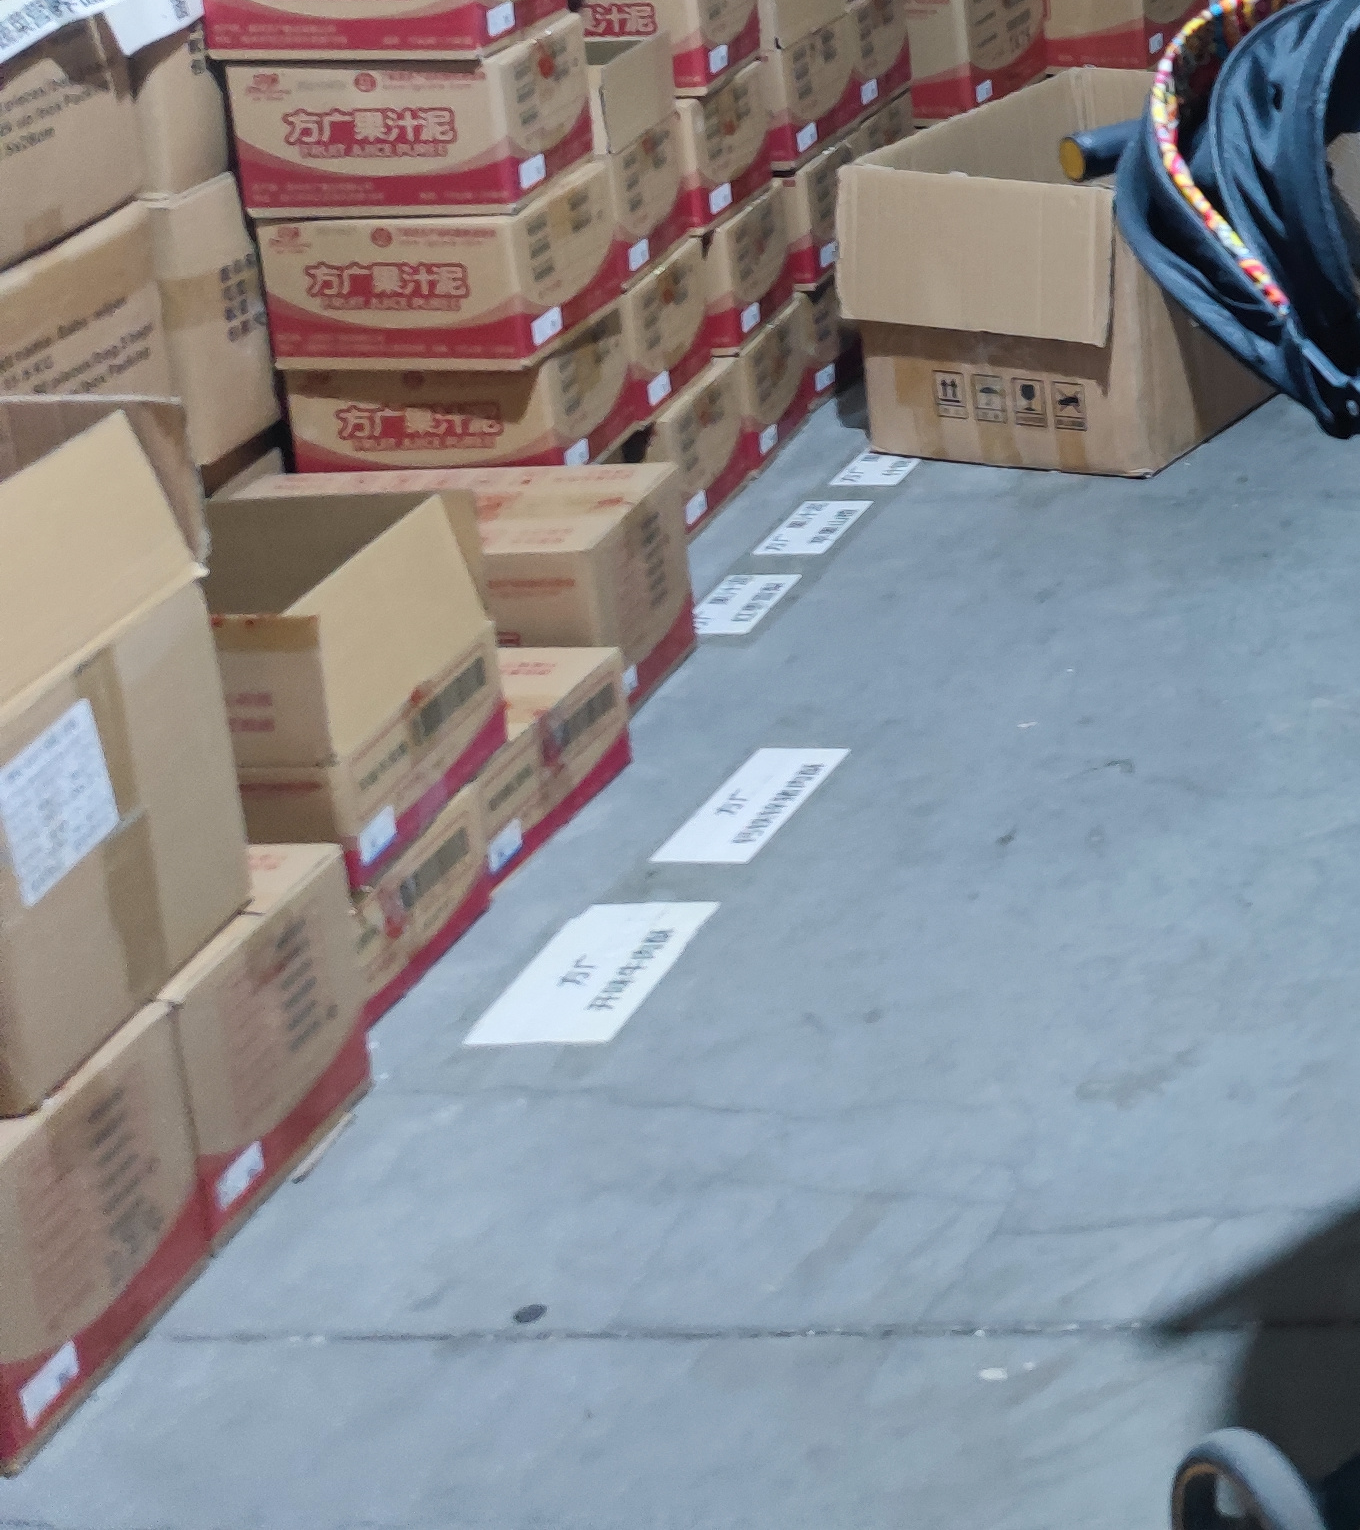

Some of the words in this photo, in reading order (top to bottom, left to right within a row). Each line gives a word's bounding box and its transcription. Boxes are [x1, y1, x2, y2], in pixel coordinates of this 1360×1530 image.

[284, 107, 458, 145] 方广果汁泥
[306, 261, 470, 299] 方广果汁泥
[714, 789, 743, 818] 方广
[556, 954, 596, 990] 方广
